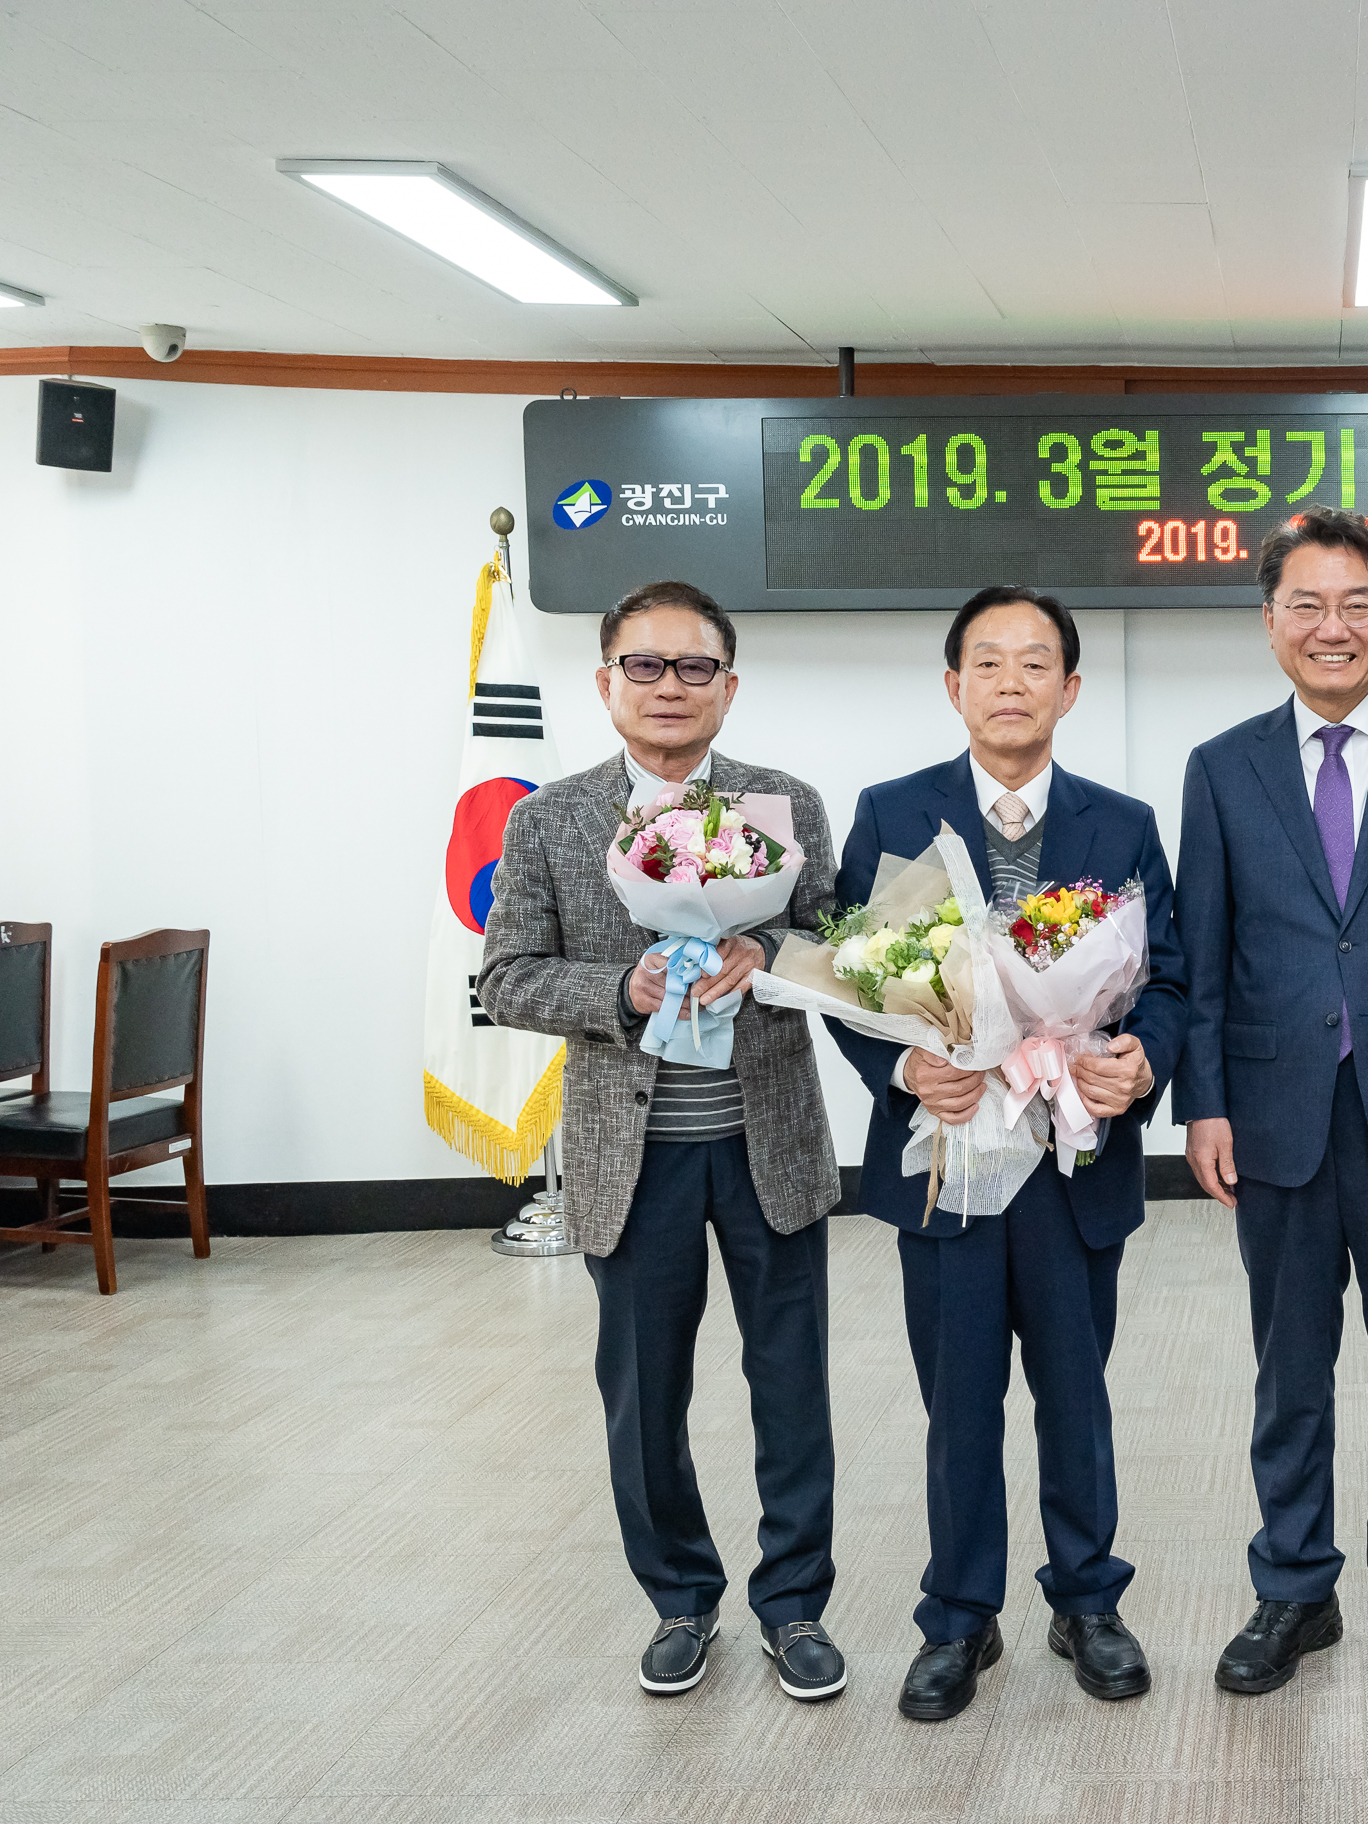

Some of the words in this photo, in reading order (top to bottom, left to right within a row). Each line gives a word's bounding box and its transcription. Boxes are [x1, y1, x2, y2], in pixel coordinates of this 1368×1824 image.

[799, 433, 1007, 510] 2019.
[1038, 428, 1160, 511] 3월
[1200, 429, 1355, 511] 정기
[619, 483, 730, 511] 광진구
[621, 513, 727, 526] GWANGJIN-GU
[1137, 519, 1249, 562] 2019.
